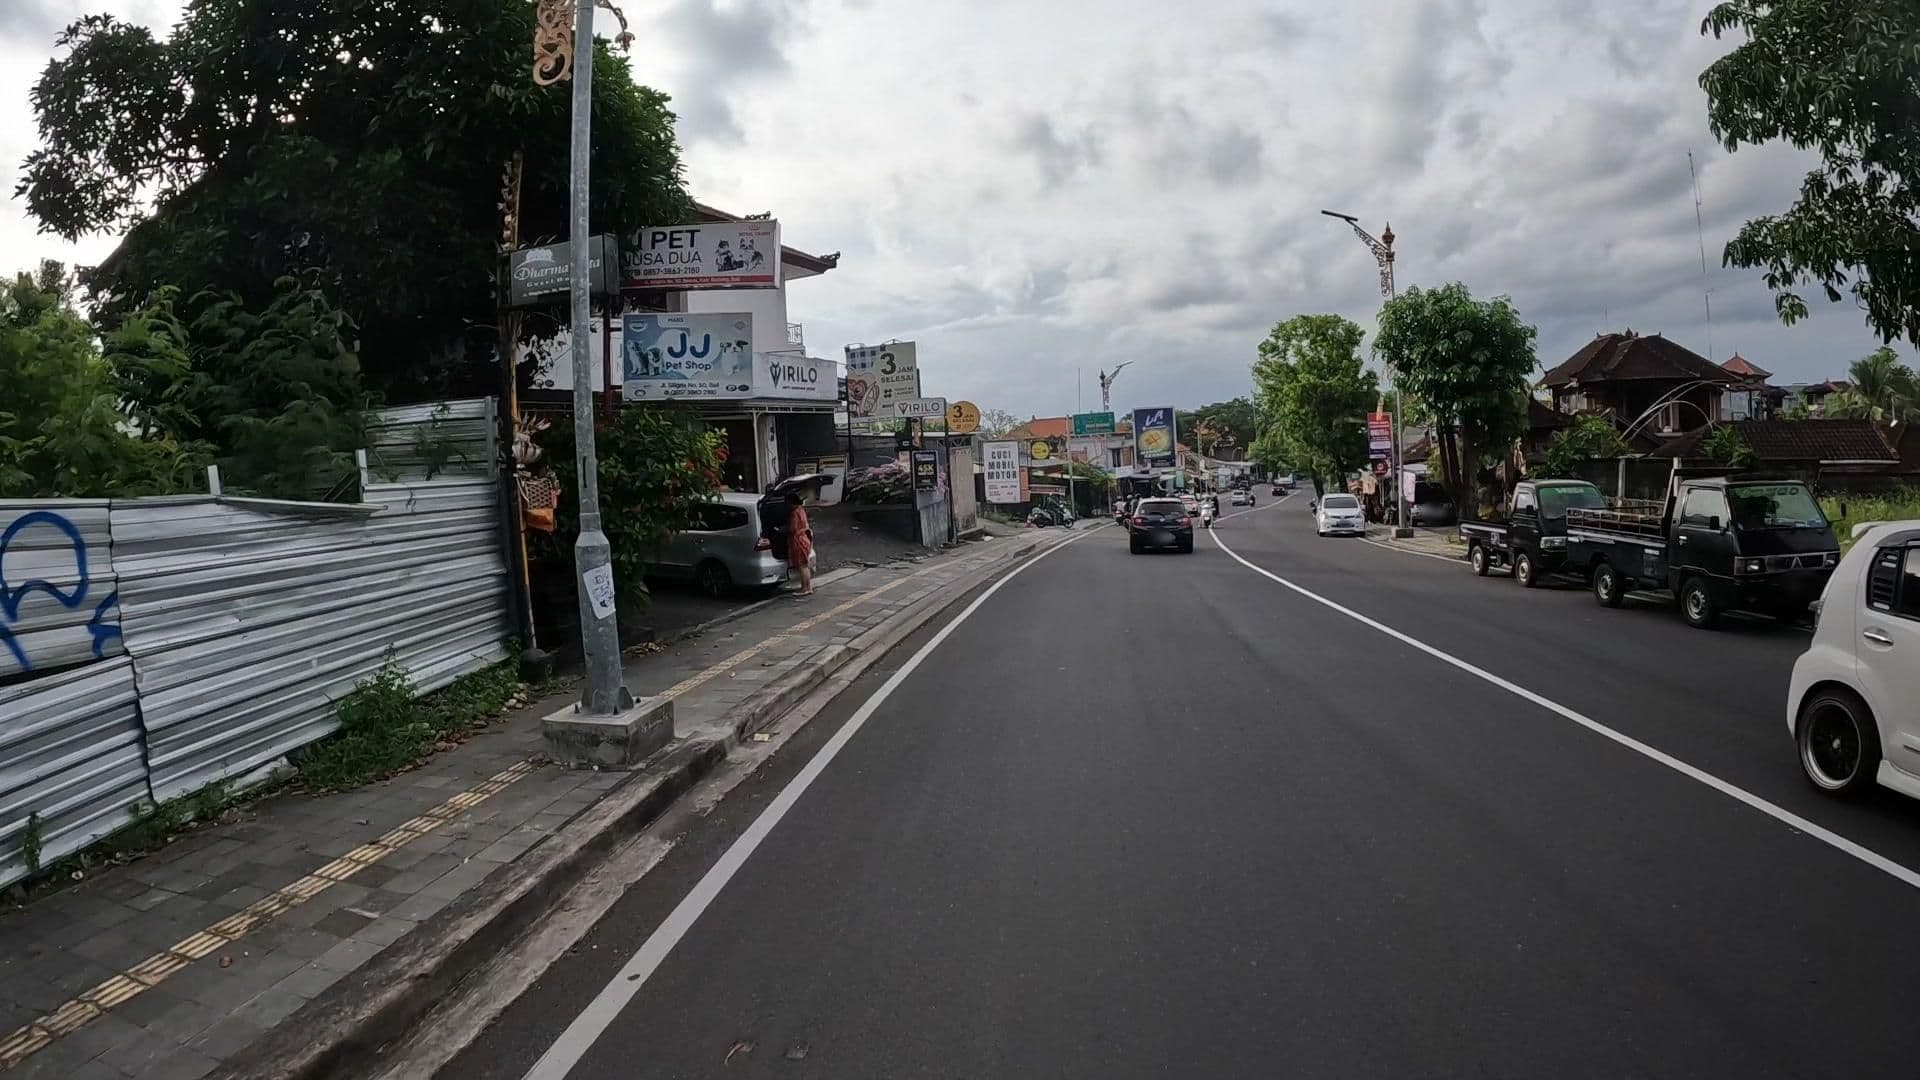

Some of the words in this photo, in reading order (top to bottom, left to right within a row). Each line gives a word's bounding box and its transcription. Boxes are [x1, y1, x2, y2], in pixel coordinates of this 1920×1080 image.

[651, 229, 701, 250] PET
[668, 250, 702, 265] DUA
[666, 332, 711, 359] JJ
[685, 360, 712, 371] Shop
[880, 353, 897, 375] 3
[880, 375, 914, 384] SELESAI
[953, 405, 963, 419] 3
[991, 451, 1011, 459] CUCI
[988, 461, 1015, 470] MOBIL
[987, 470, 1017, 480] MOTOR
